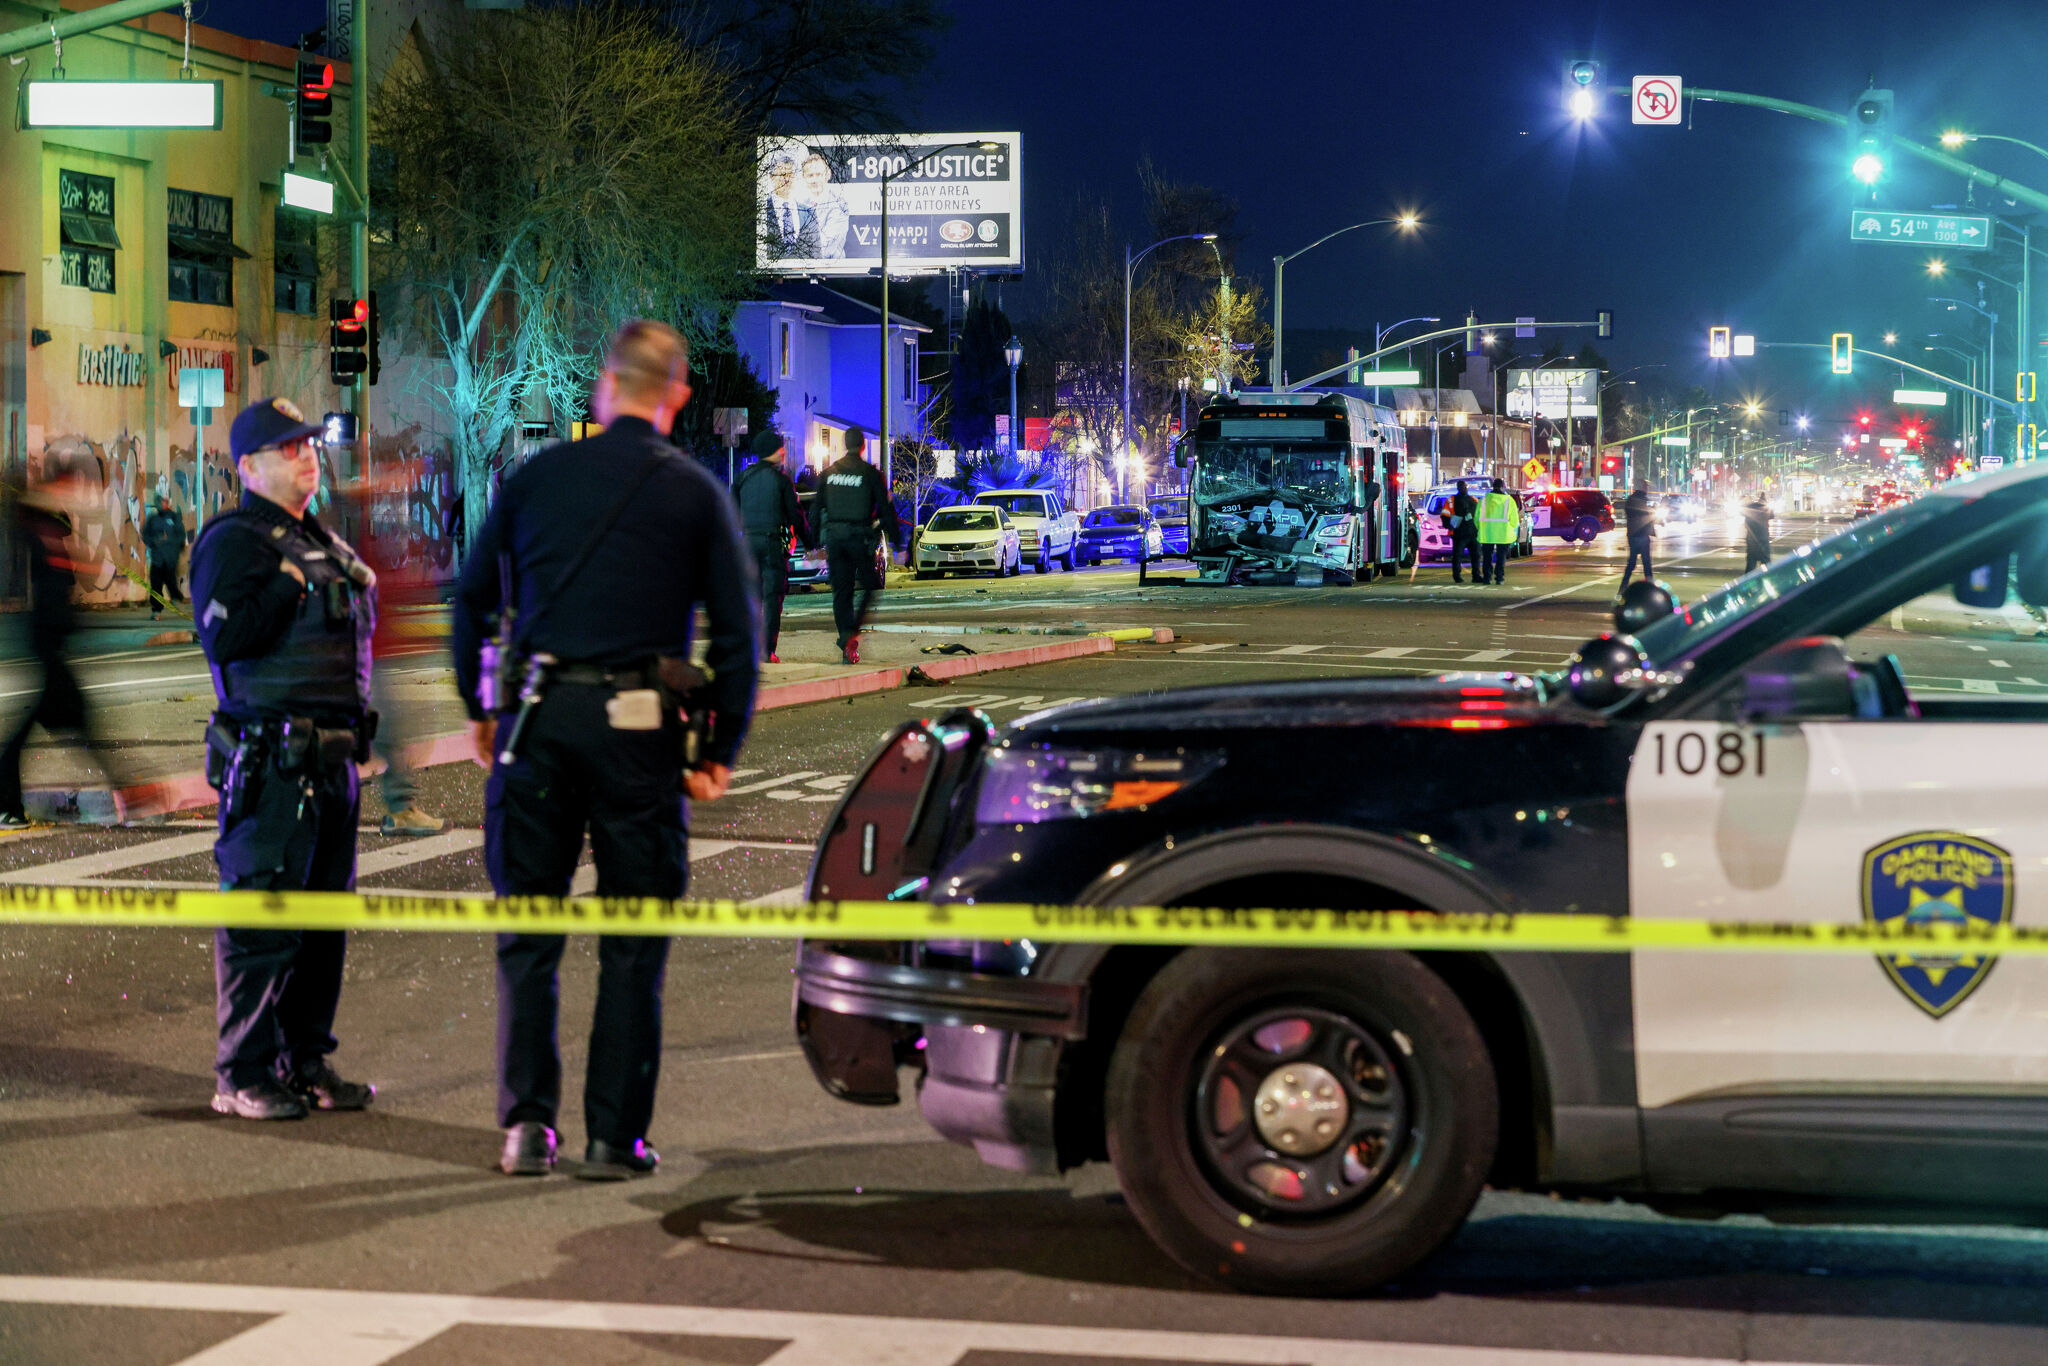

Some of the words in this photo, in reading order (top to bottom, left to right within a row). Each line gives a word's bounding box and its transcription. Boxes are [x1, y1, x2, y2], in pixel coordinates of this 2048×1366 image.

[847, 156, 907, 178] 1-800
[912, 154, 999, 178] JUSTICE
[914, 186, 936, 196] BAY
[939, 185, 970, 196] AREA
[868, 201, 911, 211] INURY
[914, 199, 982, 211] ATTORNEYS
[872, 226, 928, 237] VNARDI
[1890, 219, 1929, 237] 54th
[1937, 220, 1957, 230] Ave
[872, 237, 928, 245] zrada
[1518, 371, 1586, 387] ALONE?
[1221, 504, 1242, 513] 2301
[1254, 512, 1299, 524] TEMPO
[1654, 732, 1766, 776] 1081
[1881, 844, 1993, 876] OAKLAND
[1895, 862, 1978, 889] POLICE
